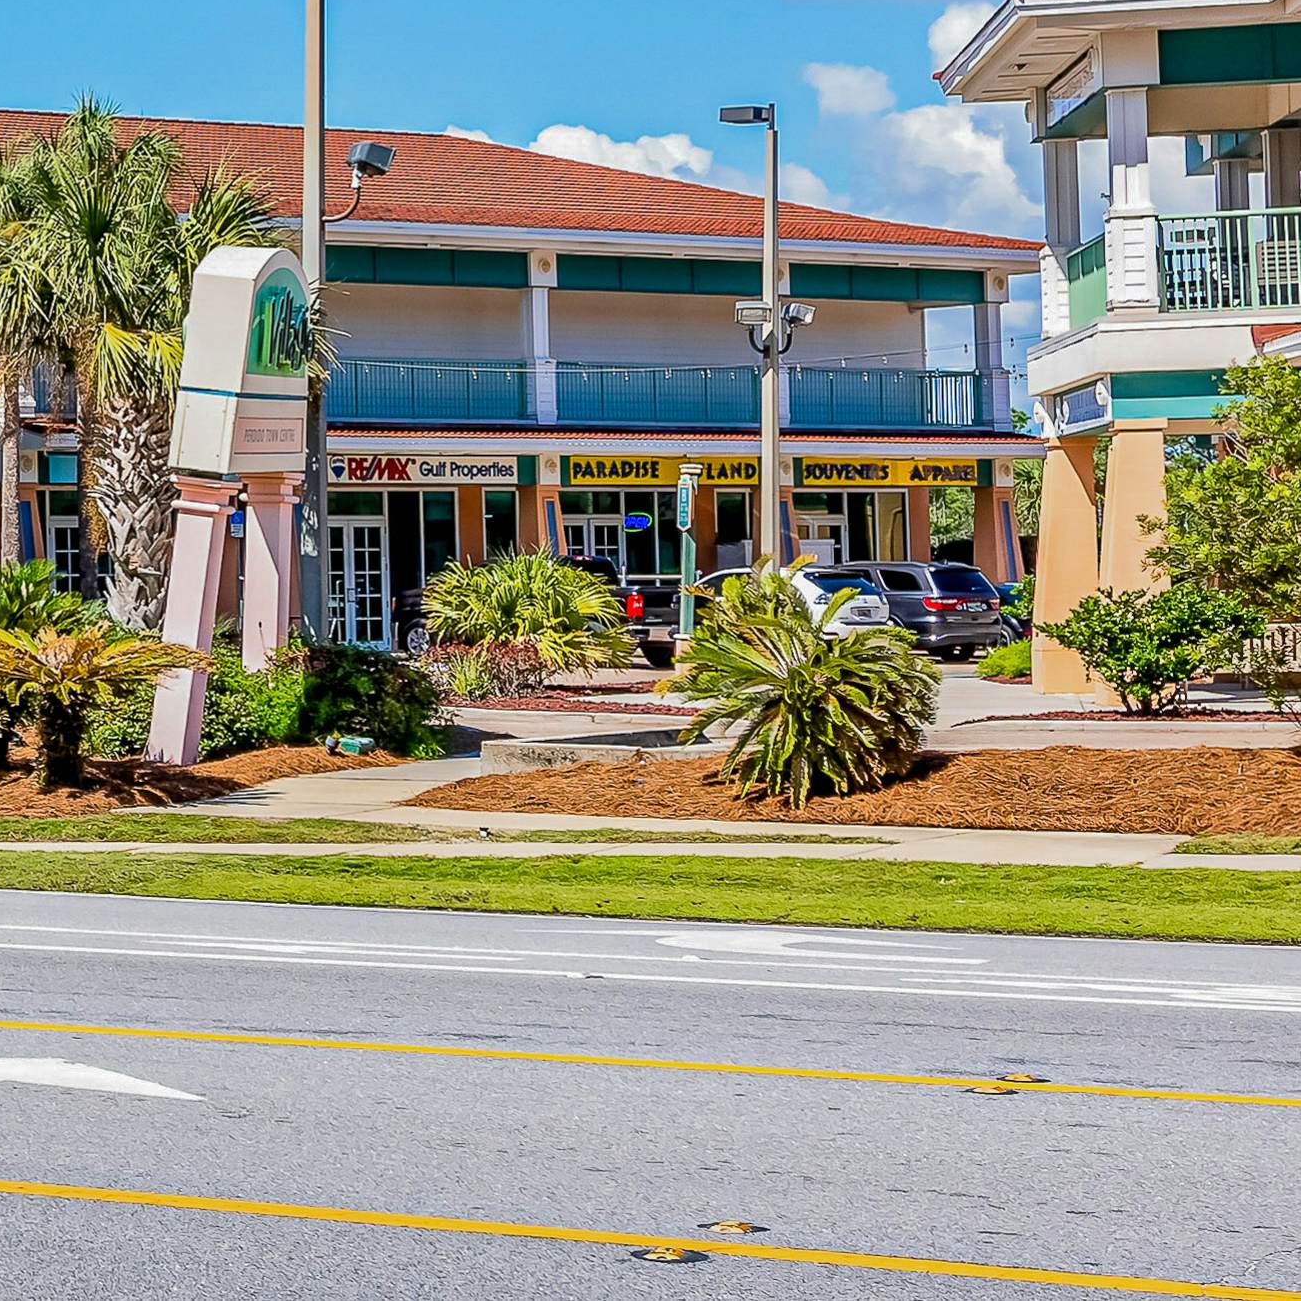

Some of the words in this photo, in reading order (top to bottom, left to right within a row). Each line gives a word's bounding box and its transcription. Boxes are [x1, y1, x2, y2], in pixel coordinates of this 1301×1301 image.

[419, 461, 446, 477] Gulf
[450, 461, 514, 480] Properties
[572, 460, 660, 479] PARADISE
[696, 462, 758, 481] LAND
